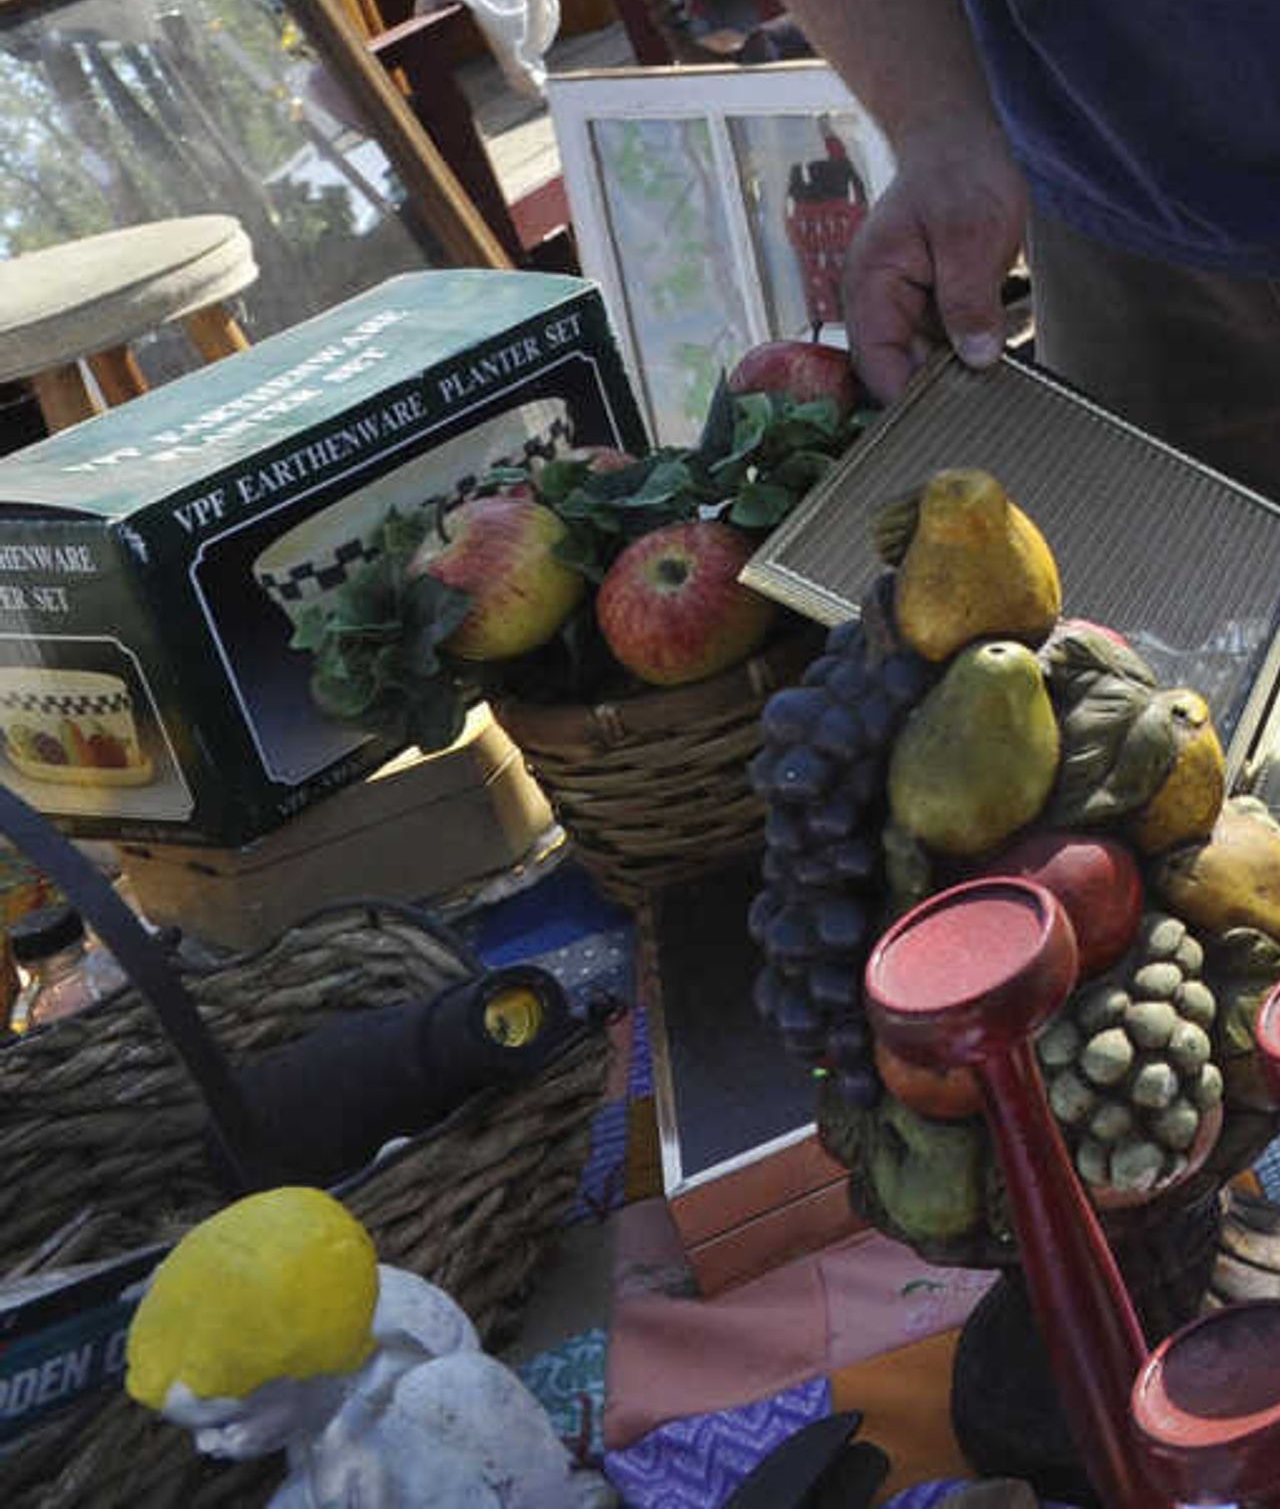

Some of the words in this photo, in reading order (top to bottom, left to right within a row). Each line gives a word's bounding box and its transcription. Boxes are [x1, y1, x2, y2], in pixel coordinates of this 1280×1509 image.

[173, 490, 228, 535] VPF
[236, 394, 428, 505] EARTHENWARE
[438, 337, 543, 404] PLANTER
[544, 312, 584, 351] SET
